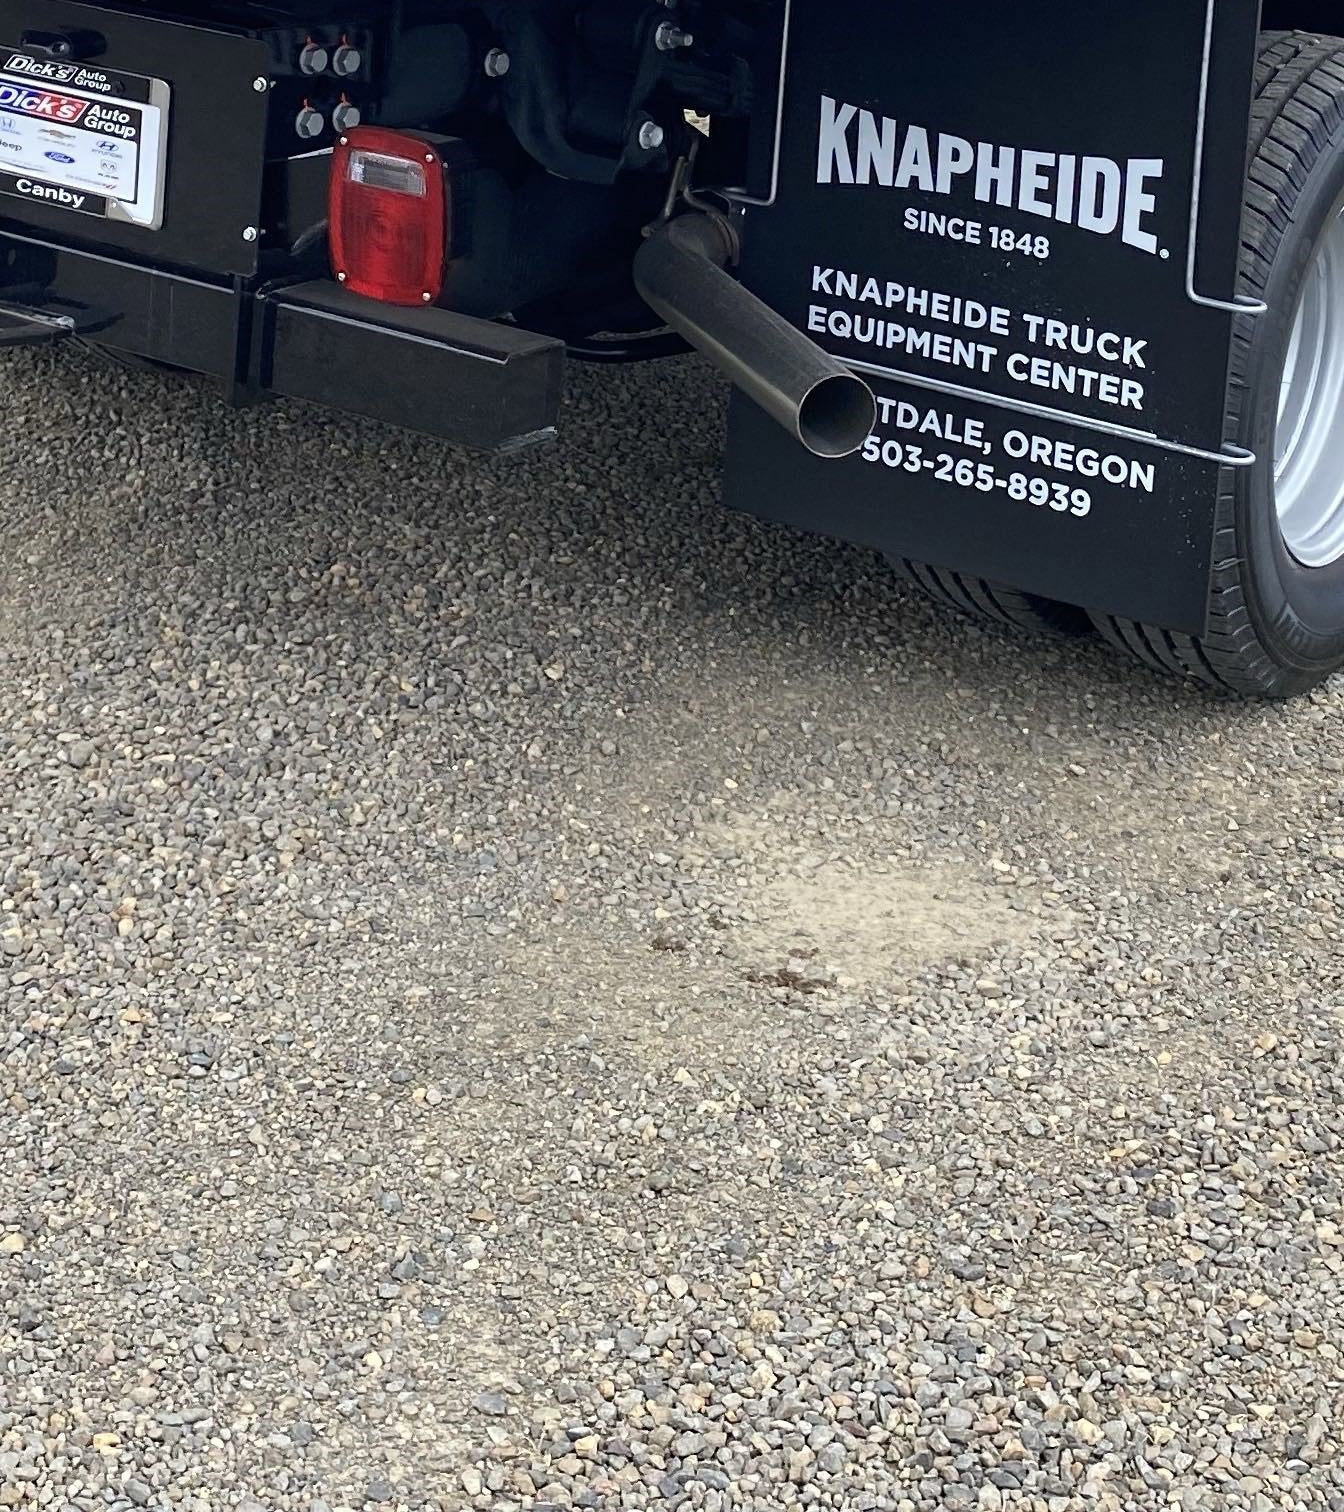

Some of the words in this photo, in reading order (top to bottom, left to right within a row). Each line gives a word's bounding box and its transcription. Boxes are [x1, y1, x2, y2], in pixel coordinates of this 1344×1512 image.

[10, 57, 69, 79] Dick's
[74, 76, 111, 92] Group
[77, 69, 106, 82] Auto
[84, 117, 136, 139] Group
[88, 104, 130, 123] Auto
[16, 179, 85, 208] Canby
[816, 95, 1164, 255] KNAPHEIDE
[904, 207, 981, 244] SINCE
[989, 226, 1050, 259] 1848
[811, 266, 1010, 336] KNAPHEIDE
[1023, 313, 1147, 368] TRUCK
[808, 305, 997, 373] EQUIPMENT
[1007, 353, 1143, 410] CENTER
[862, 435, 1091, 517] 503-265-8939
[1003, 430, 1155, 492] OREGON
